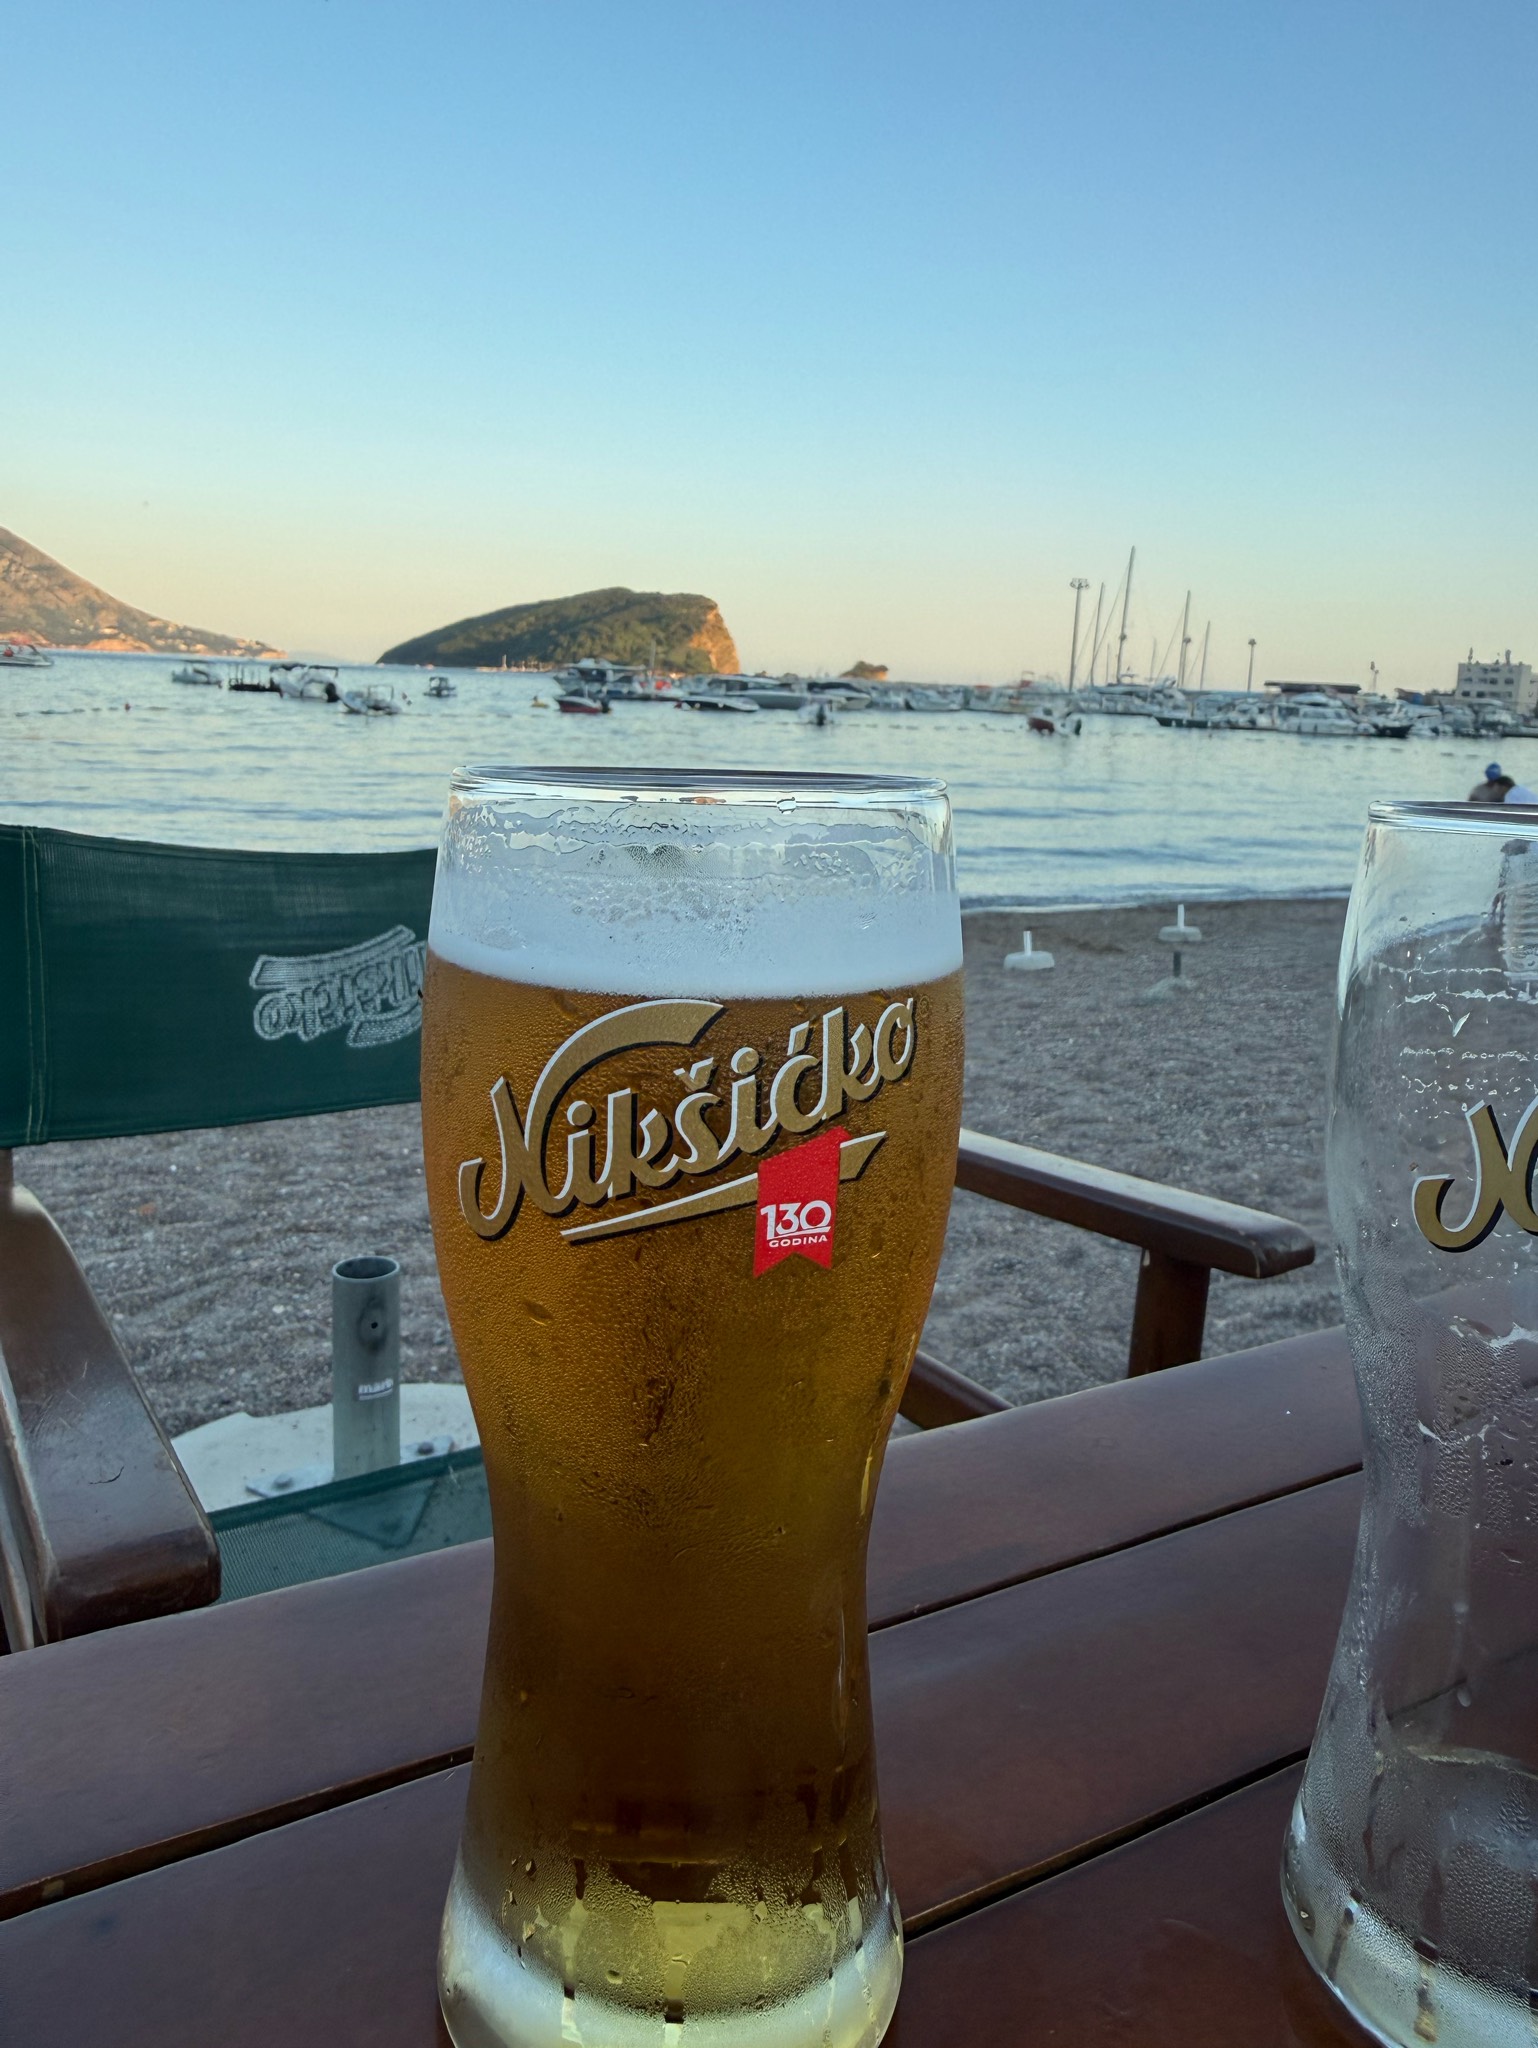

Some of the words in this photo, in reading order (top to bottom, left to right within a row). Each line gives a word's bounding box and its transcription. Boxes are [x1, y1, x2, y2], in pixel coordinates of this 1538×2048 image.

[458, 998, 916, 1241] Nikšićko
[760, 1200, 832, 1241] 130
[768, 1234, 828, 1248] GODINA
